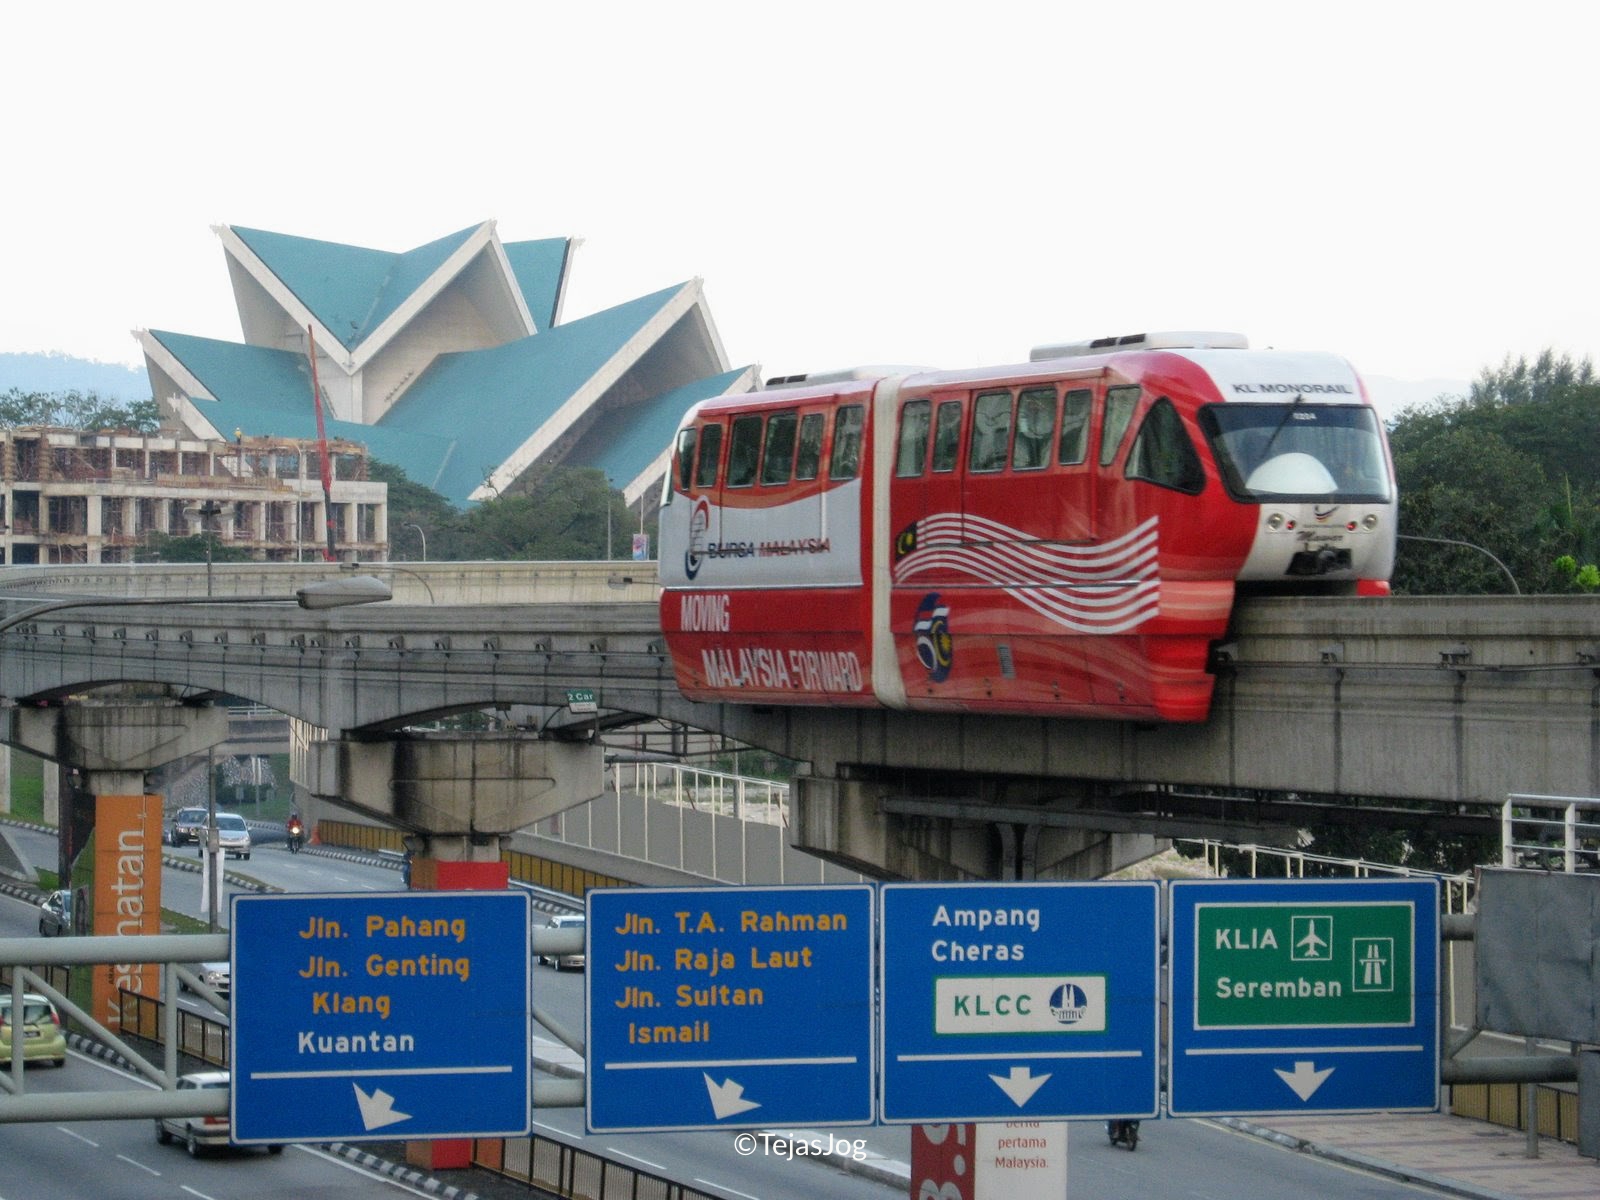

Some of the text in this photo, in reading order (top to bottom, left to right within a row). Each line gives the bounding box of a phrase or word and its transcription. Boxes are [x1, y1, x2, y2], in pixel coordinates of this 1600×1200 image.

[1232, 384, 1354, 395] KL MONORAIL
[708, 537, 832, 560] BURSA MALAYSIA
[680, 594, 730, 632] MOVING
[702, 648, 863, 691] MALAYSIA FORWARD
[299, 915, 465, 943] Jln. Pahang
[615, 910, 847, 935] Jln. T.A. Rahman
[932, 905, 1040, 932] Ampang
[1215, 928, 1278, 949] KLIA
[615, 947, 812, 977] Jln. Raja Laut
[931, 940, 1024, 962] Cheras
[299, 954, 469, 981] Jln. Genting
[615, 985, 763, 1009] Jln. Sultan
[1216, 977, 1342, 999] Seremban
[313, 992, 390, 1019] Klang
[954, 994, 1031, 1017] KLCC
[298, 1031, 414, 1053] Kuantan
[629, 1021, 709, 1044] Ismail
[998, 1137, 1047, 1150] pertama
